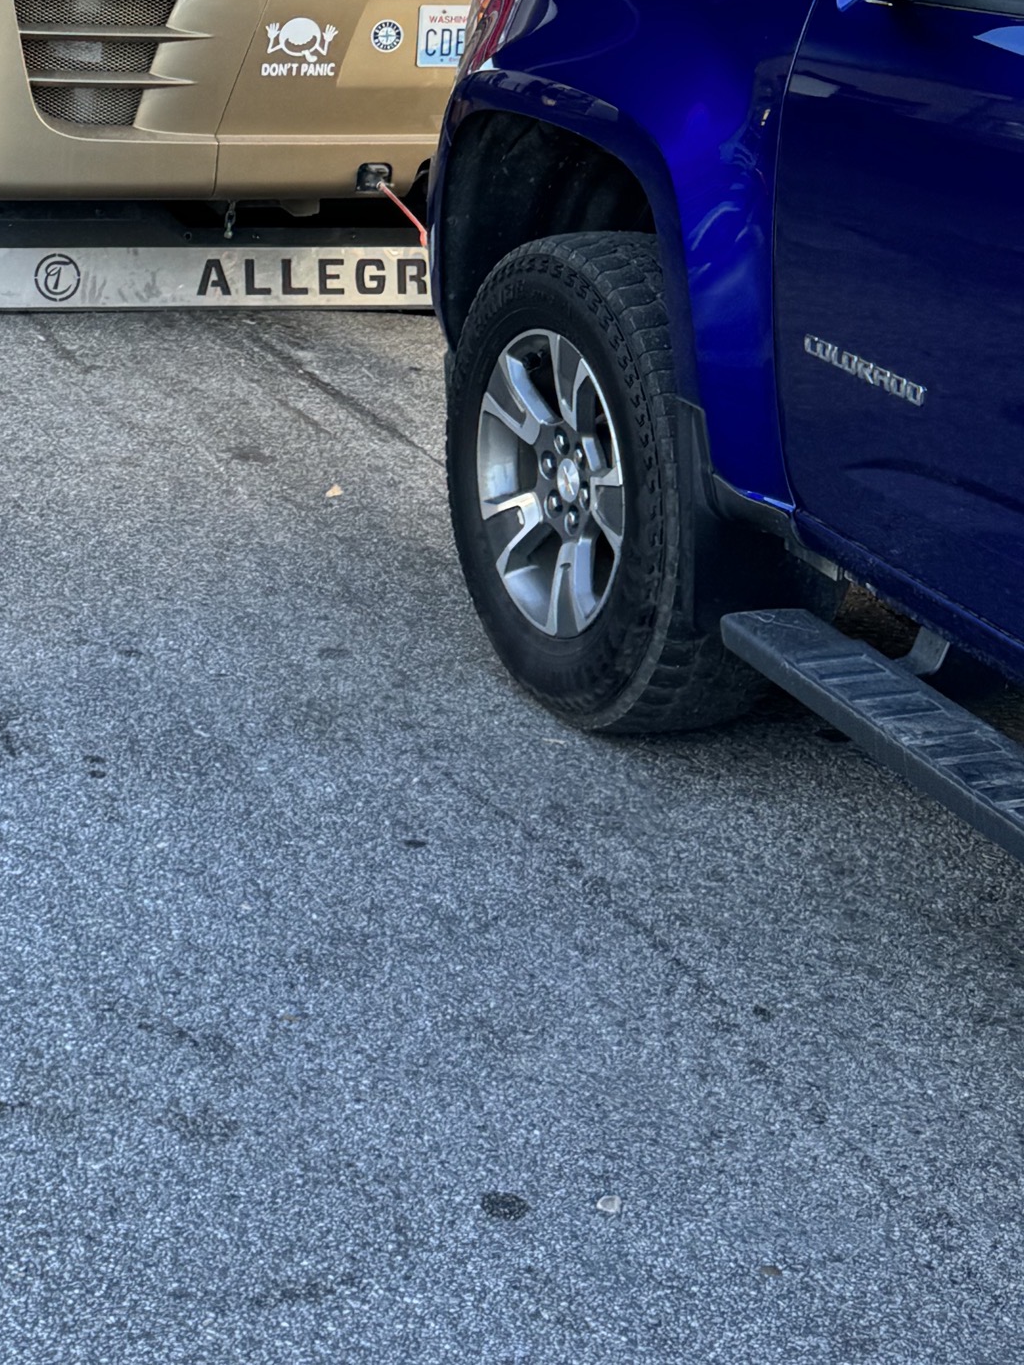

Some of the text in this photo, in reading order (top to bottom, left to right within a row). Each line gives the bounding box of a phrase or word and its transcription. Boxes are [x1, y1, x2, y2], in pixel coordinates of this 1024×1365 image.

[429, 15, 467, 25] WASHIN
[425, 28, 466, 57] CDE
[261, 62, 336, 77] DON'T PANIC
[196, 258, 428, 296] ALLEGR
[803, 334, 926, 408] COLORADO
